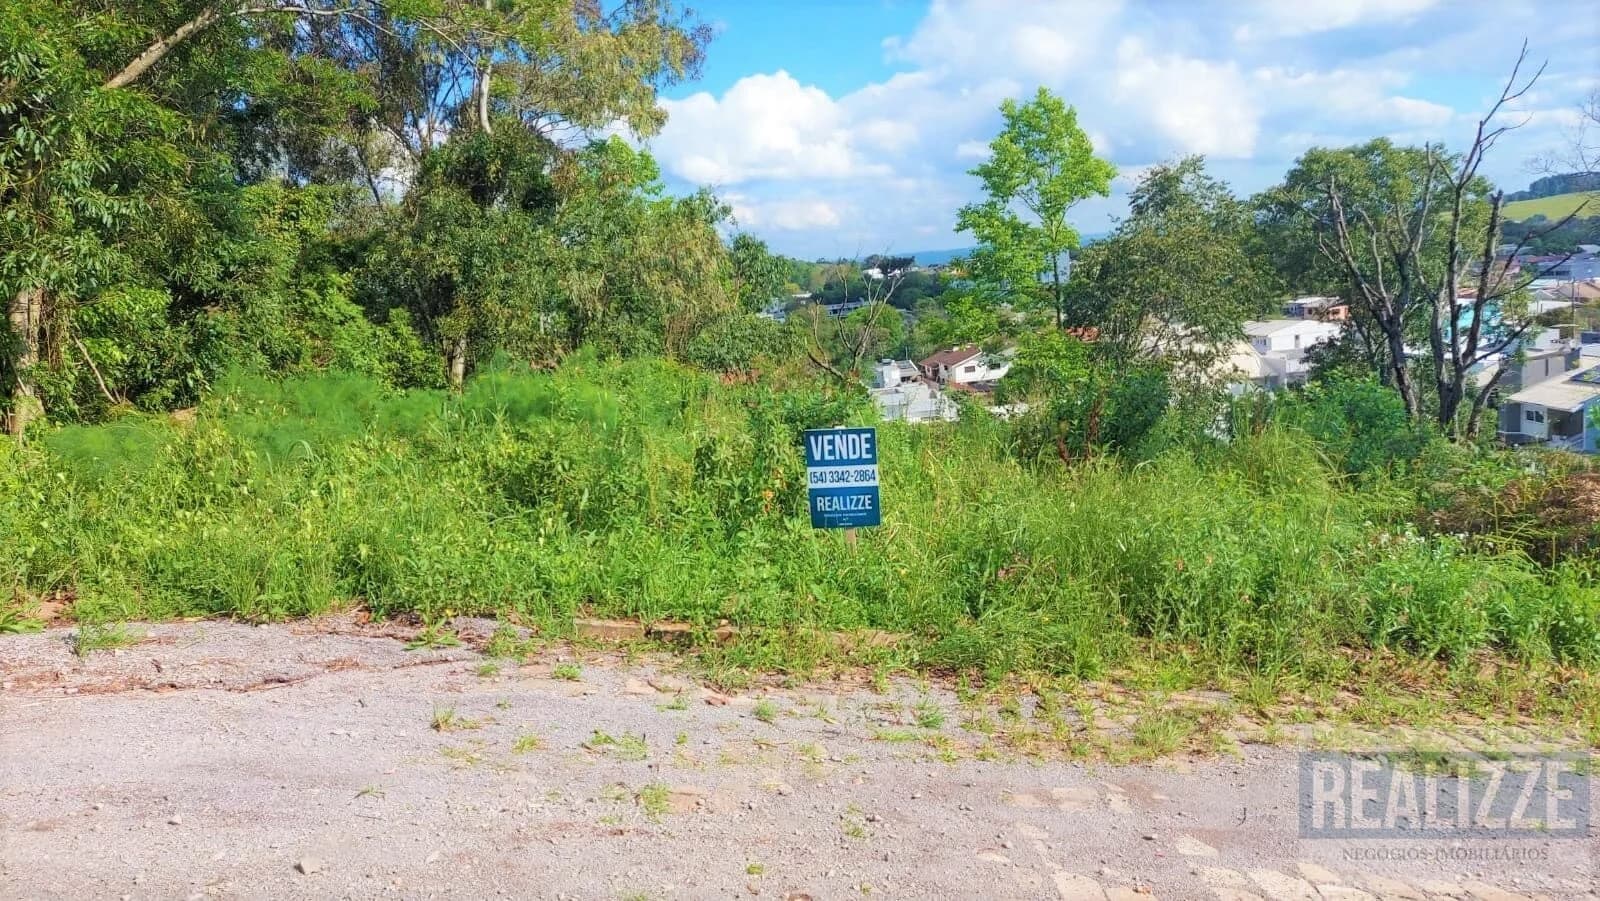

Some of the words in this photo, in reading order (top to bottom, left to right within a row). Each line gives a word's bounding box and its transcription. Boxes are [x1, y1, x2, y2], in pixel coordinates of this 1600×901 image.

[810, 432, 871, 460] VENDE
[810, 471, 827, 484] (54)
[829, 469, 876, 483] 3342-2864
[816, 494, 872, 512] REALIZZE
